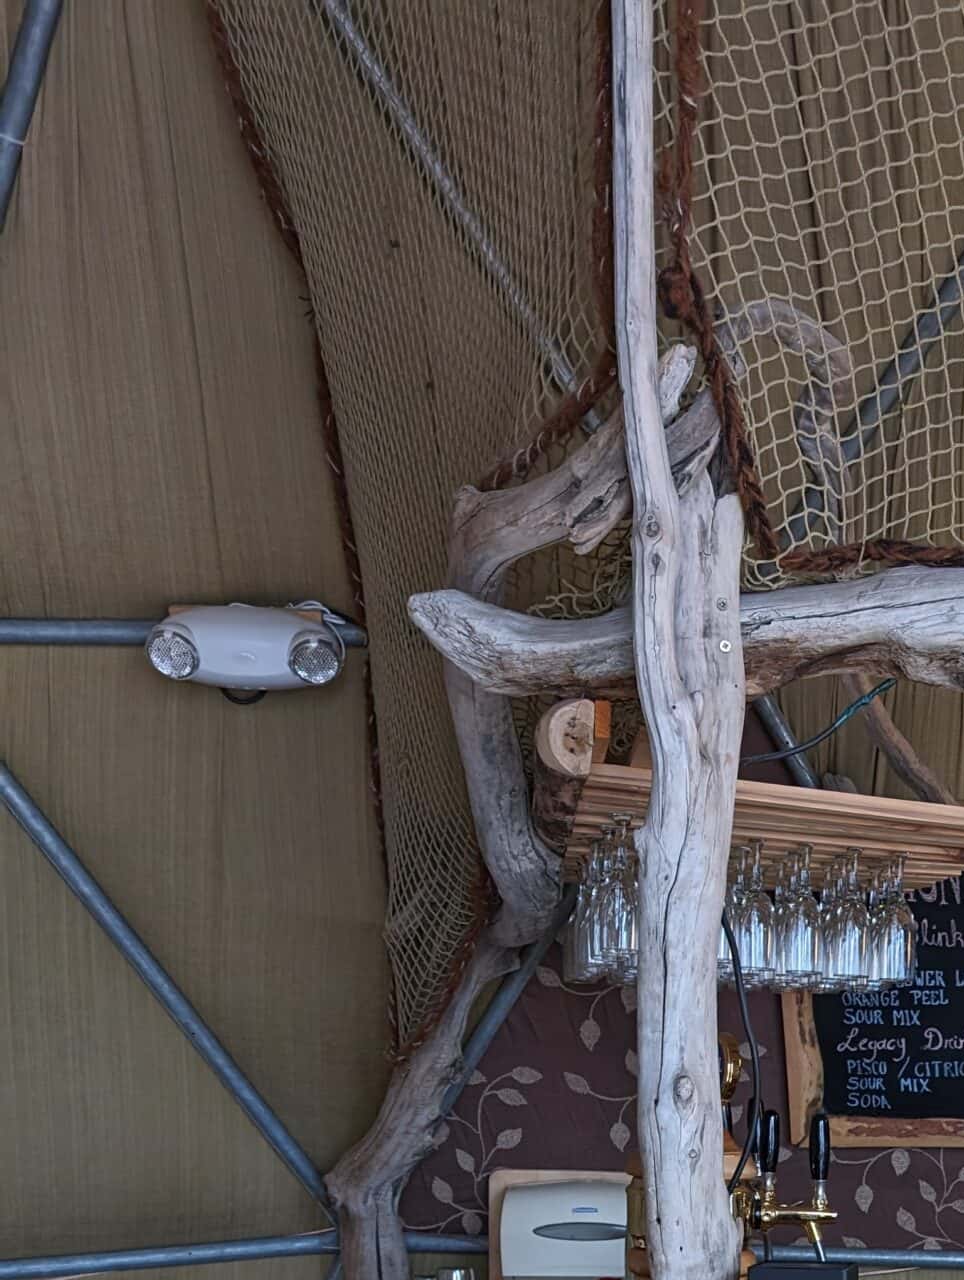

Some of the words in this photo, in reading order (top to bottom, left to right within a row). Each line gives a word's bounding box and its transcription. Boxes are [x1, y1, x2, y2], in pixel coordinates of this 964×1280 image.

[841, 990, 900, 1007] ORANGE
[910, 989, 949, 1006] PEEL
[843, 1009, 885, 1025] SOUR
[893, 1009, 921, 1026] MIX
[836, 1027, 907, 1063] Legacy
[846, 1076, 887, 1091] SOUR
[900, 1078, 933, 1093] MIX
[846, 1092, 892, 1109] SODA
